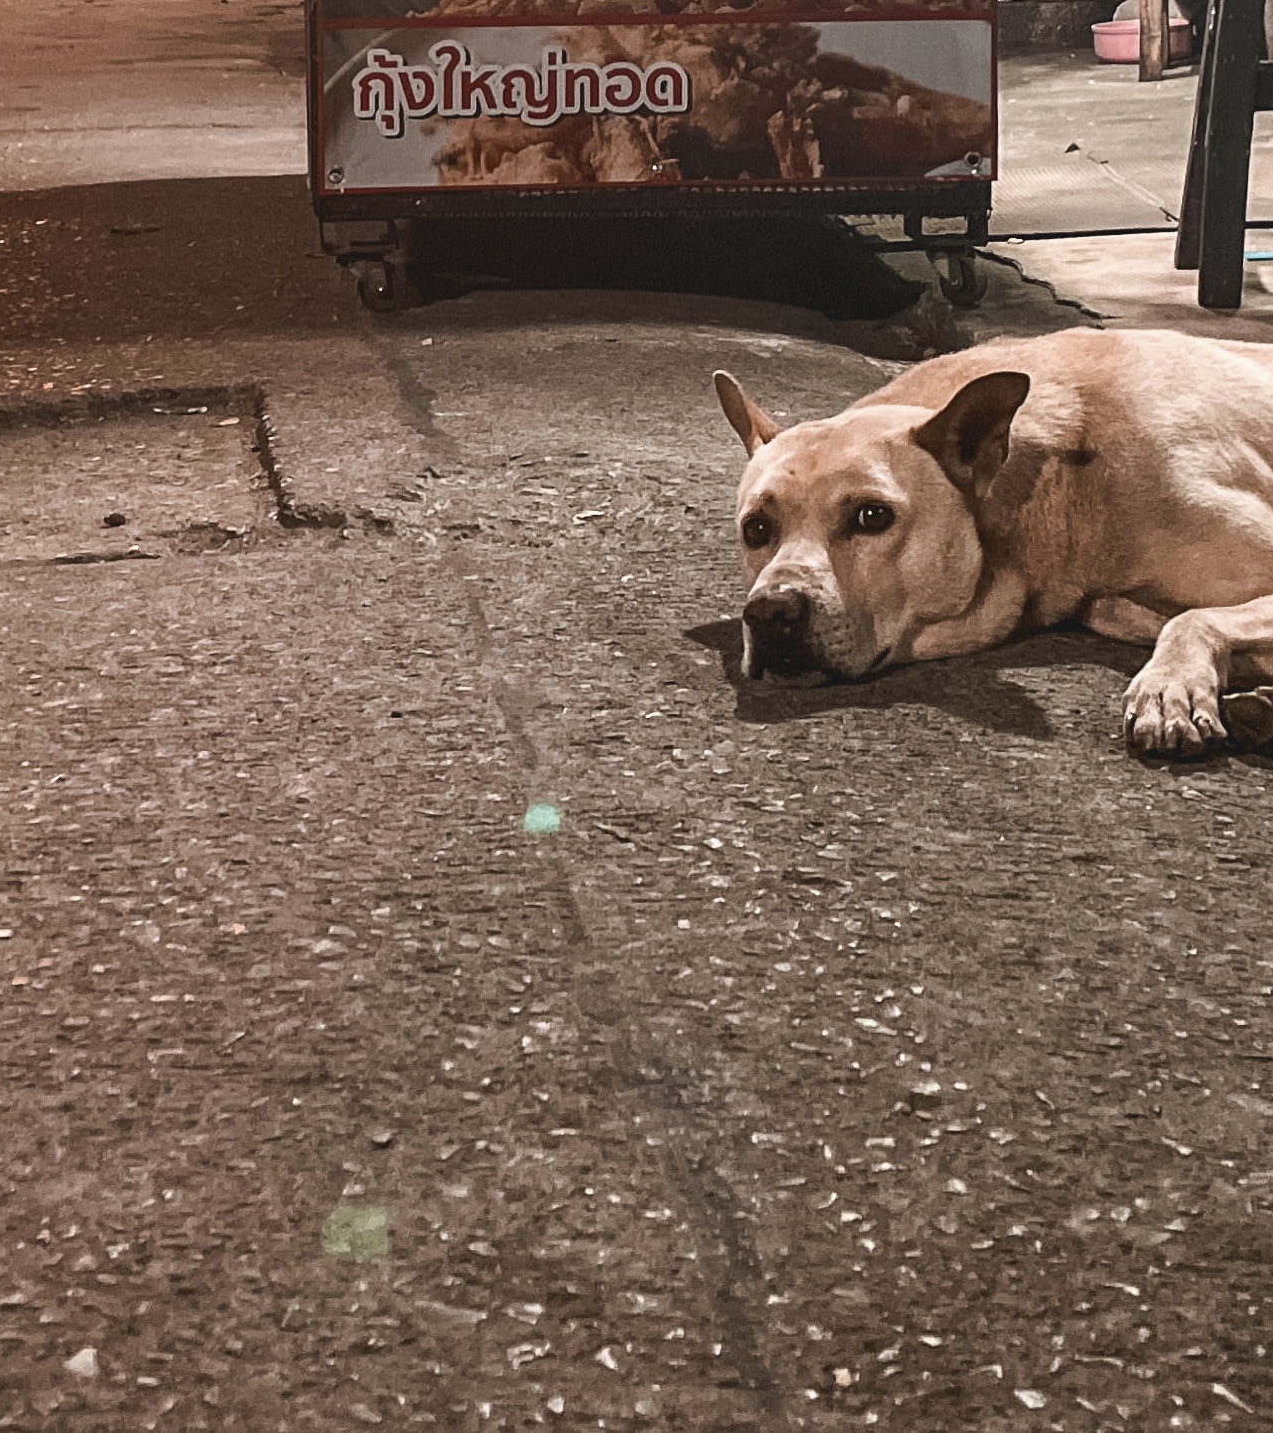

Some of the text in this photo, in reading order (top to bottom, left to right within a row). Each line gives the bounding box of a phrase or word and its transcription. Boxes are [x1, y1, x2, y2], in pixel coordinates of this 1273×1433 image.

[355, 42, 687, 134] กุ้งใหญ่ทอด
